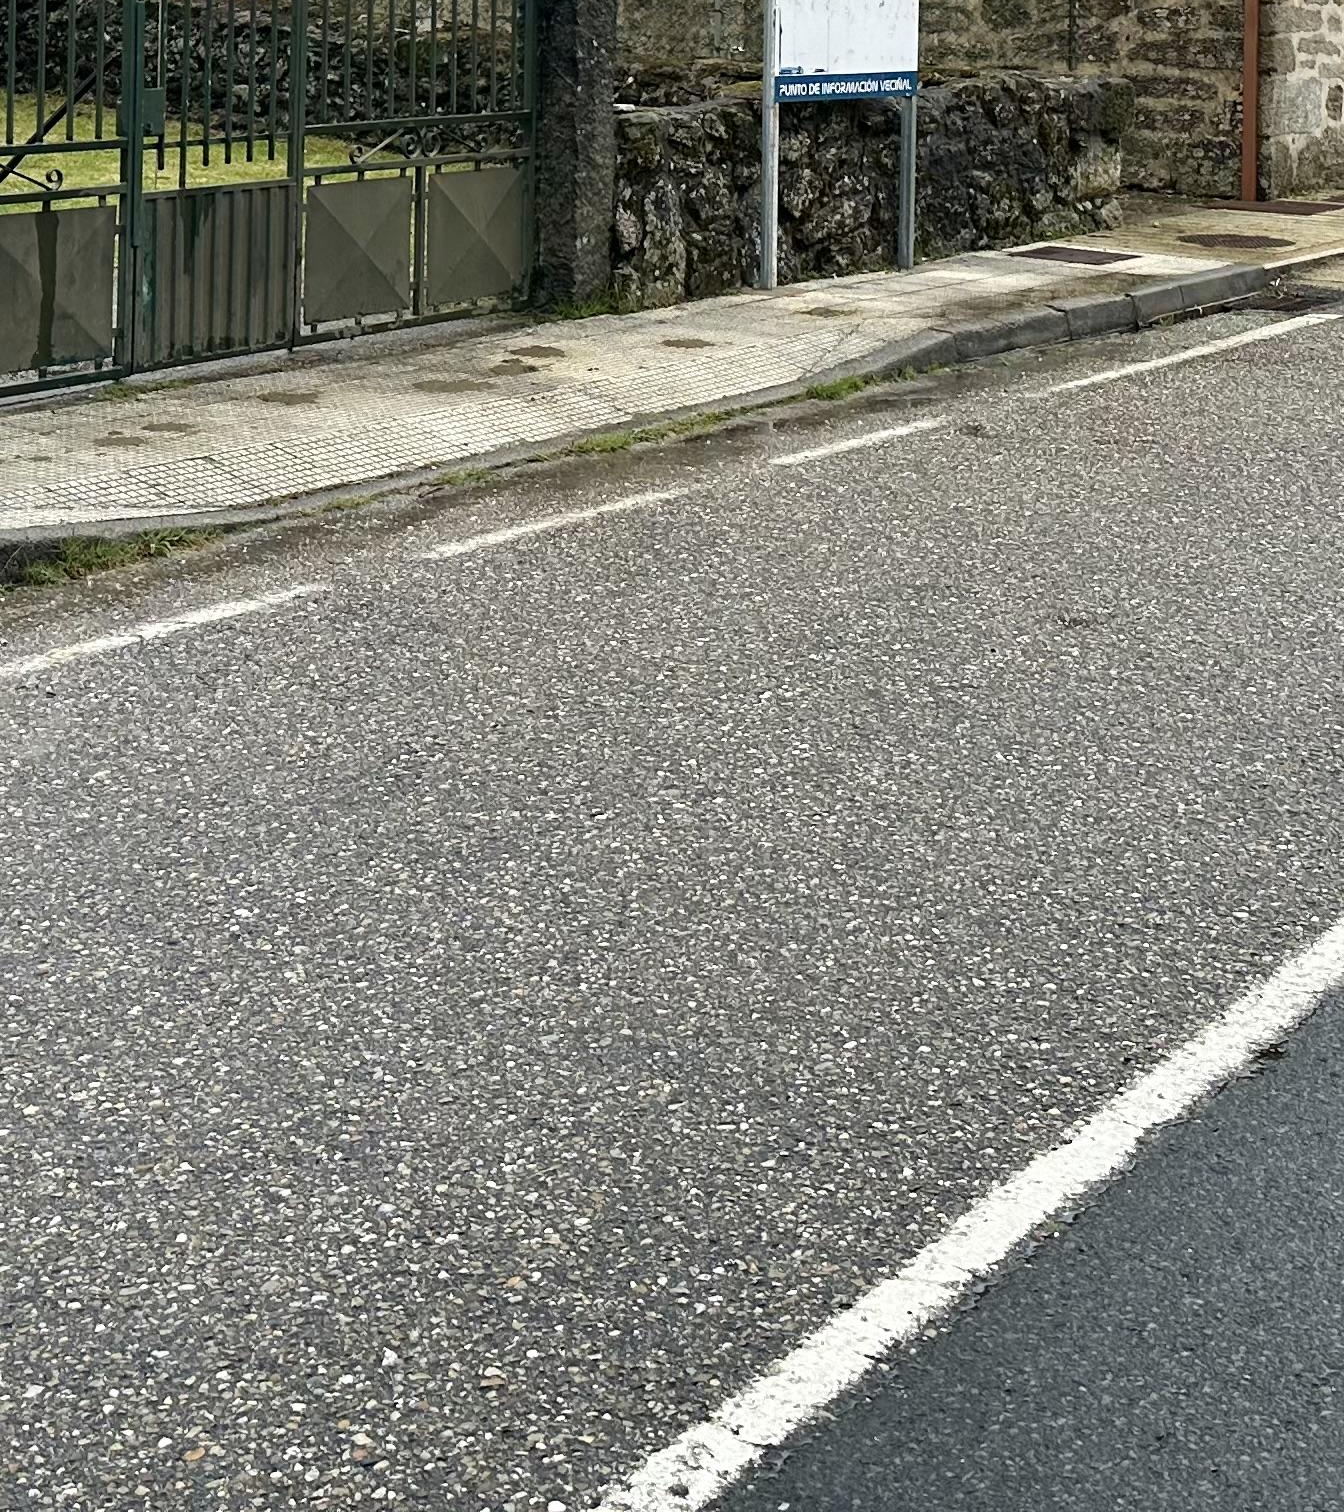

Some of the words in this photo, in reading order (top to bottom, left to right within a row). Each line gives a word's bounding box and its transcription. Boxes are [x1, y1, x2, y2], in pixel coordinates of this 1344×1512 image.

[779, 84, 807, 96] PUNTO
[809, 83, 820, 94] DE
[822, 78, 878, 94] INFORMACIÓN
